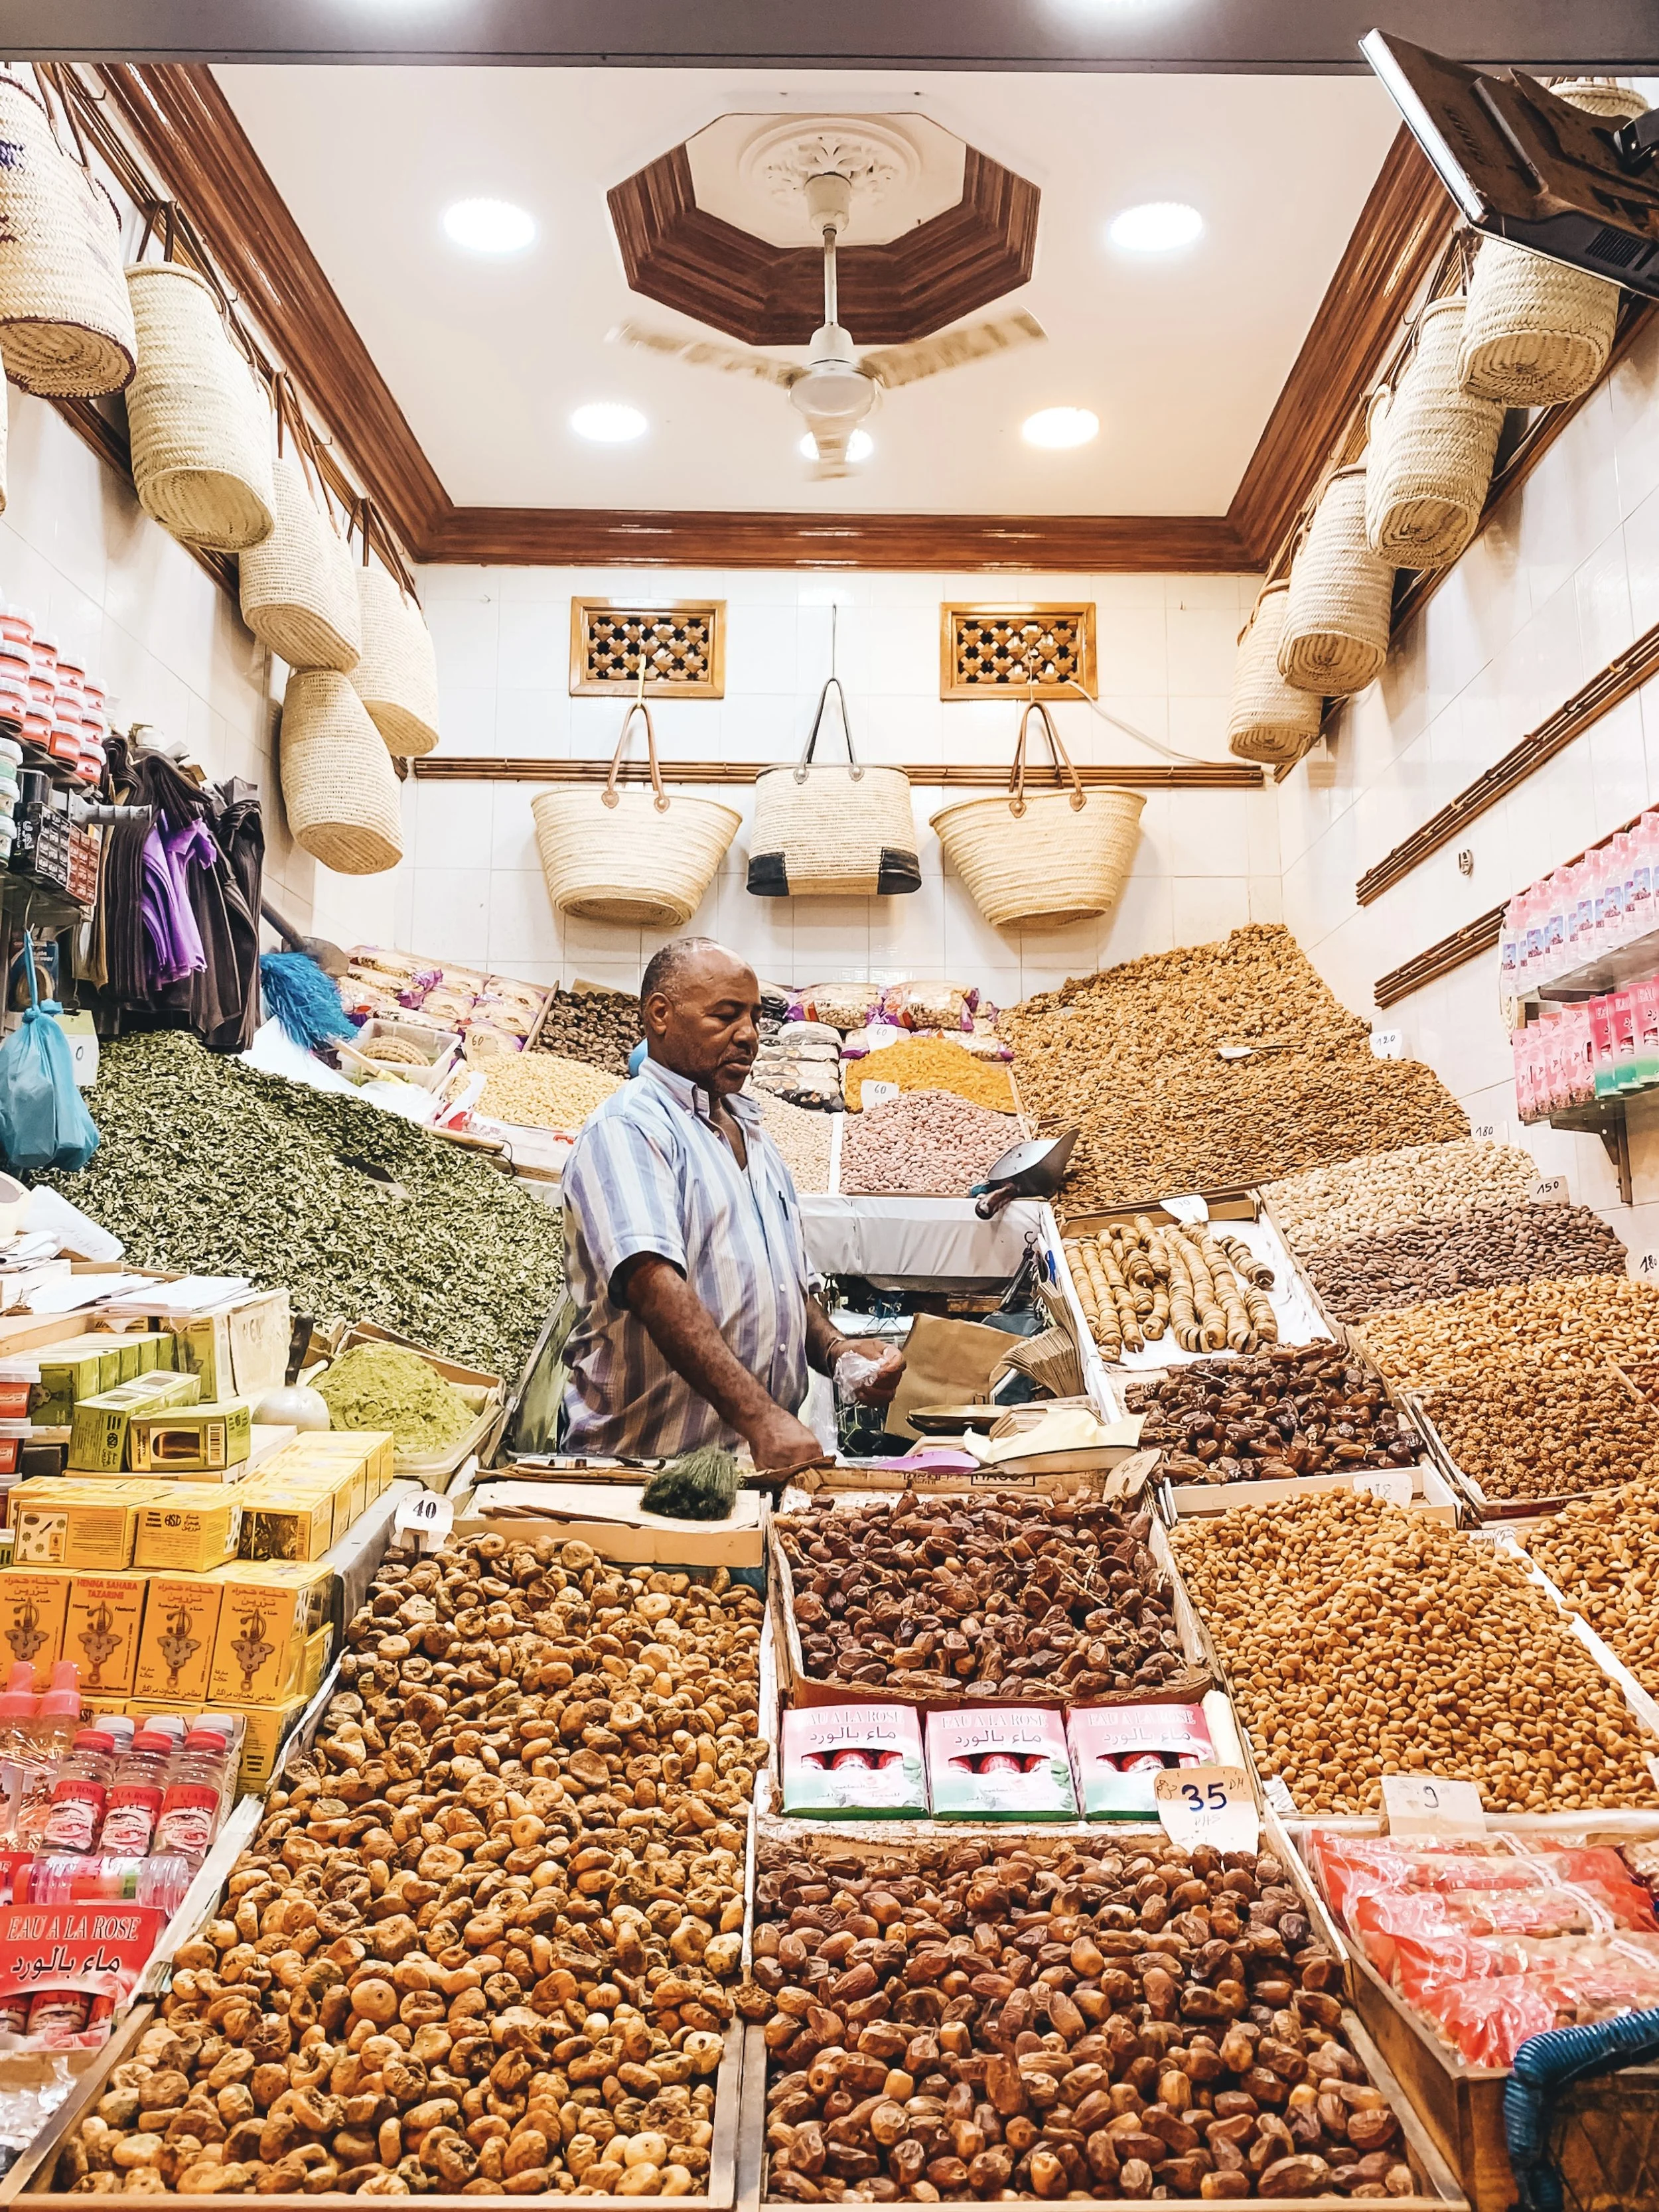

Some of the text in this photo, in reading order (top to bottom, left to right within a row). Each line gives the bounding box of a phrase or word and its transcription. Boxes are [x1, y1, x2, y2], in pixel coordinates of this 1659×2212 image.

[472, 1035, 484, 1046] 60
[877, 1028, 887, 1036] 60
[1376, 1035, 1395, 1046] 120
[875, 1084, 887, 1094] 60
[1476, 1126, 1493, 1136] 180
[1537, 1181, 1559, 1194] 150
[1121, 1456, 1147, 1477] 45
[413, 1499, 437, 1519] 40
[77, 1578, 137, 1590] HENNA SAHARA
[810, 1726, 897, 1745] ماء بالورد
[955, 1729, 1042, 1748] ماء بالورد
[1104, 1728, 1190, 1746] ماء بالورد
[1182, 1782, 1227, 1811] 35
[7, 1915, 140, 1941] EAU A LA ROSE
[11, 1945, 121, 1980] ماء بالورد
